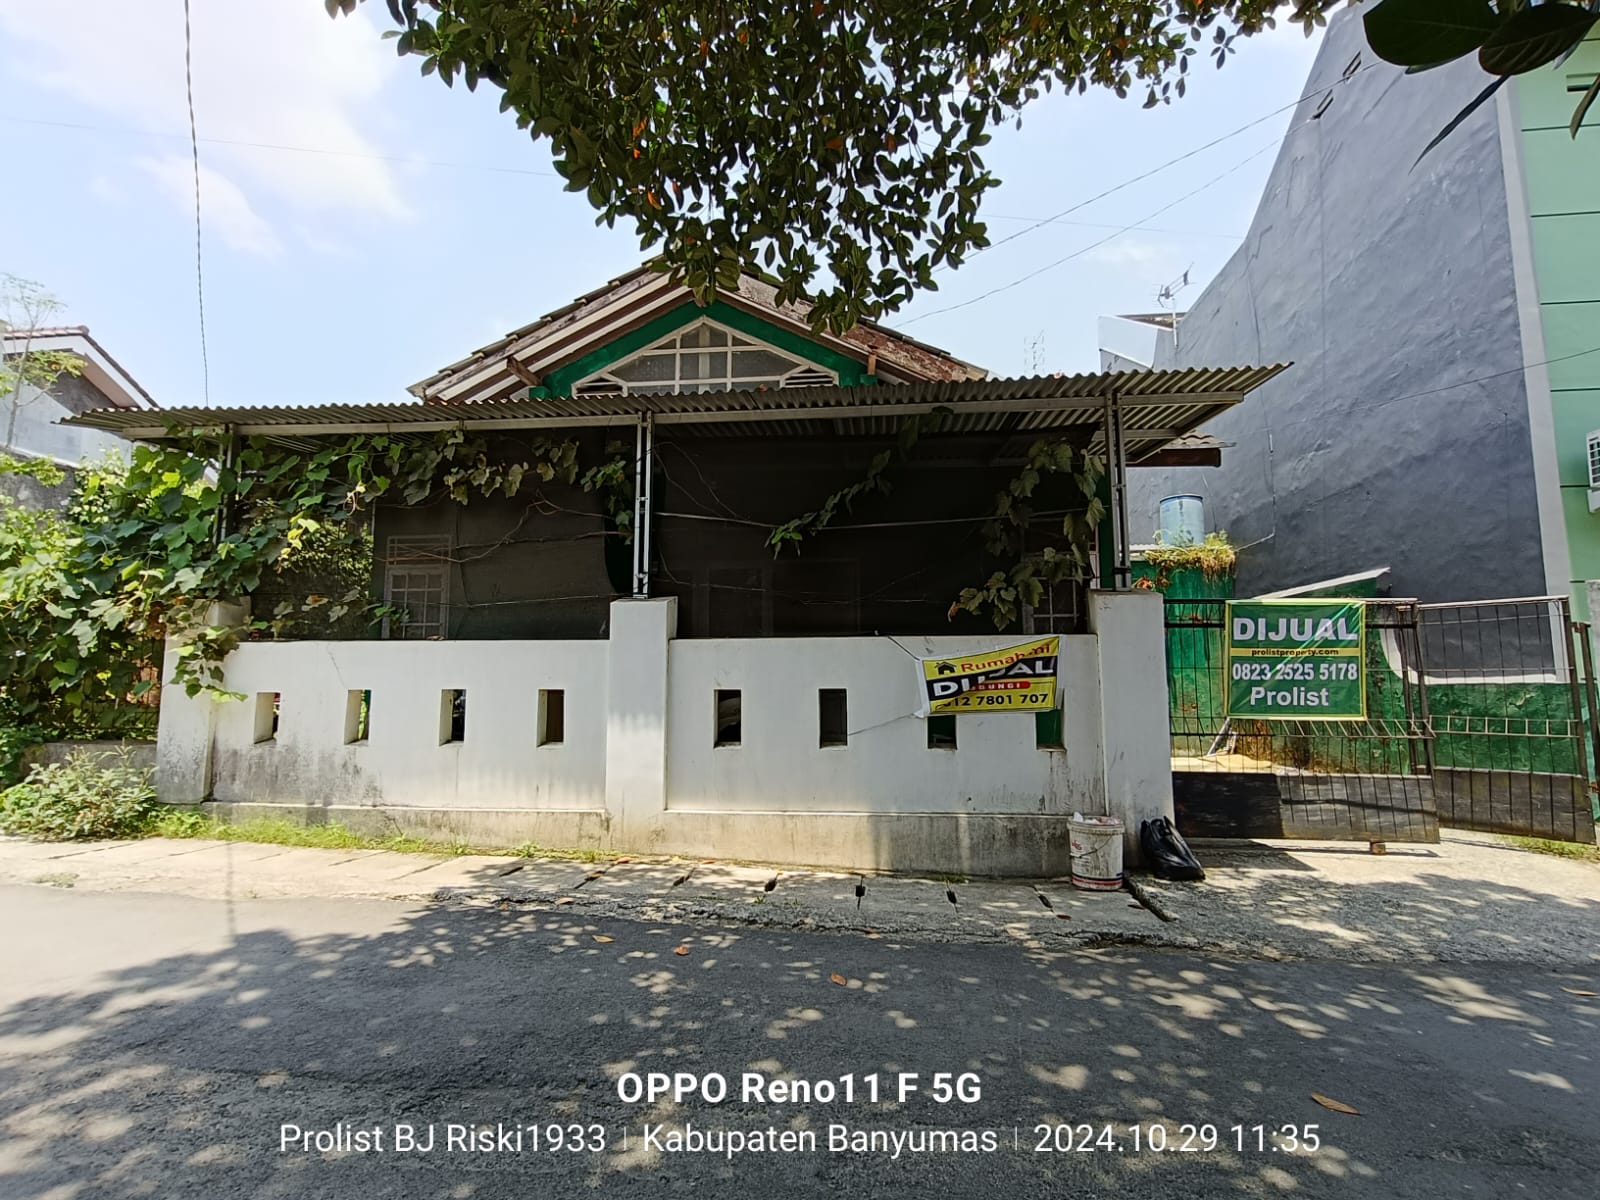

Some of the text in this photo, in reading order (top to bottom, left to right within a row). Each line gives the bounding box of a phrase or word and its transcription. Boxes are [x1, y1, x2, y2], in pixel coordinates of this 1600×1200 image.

[1233, 617, 1358, 641] DIJUAL
[1251, 648, 1339, 657] prolistproperty.com
[1232, 663, 1358, 681] 0823 2525 5178
[976, 694, 1013, 705] 7801
[1020, 693, 1049, 704] 707
[1250, 686, 1329, 706] Prolist
